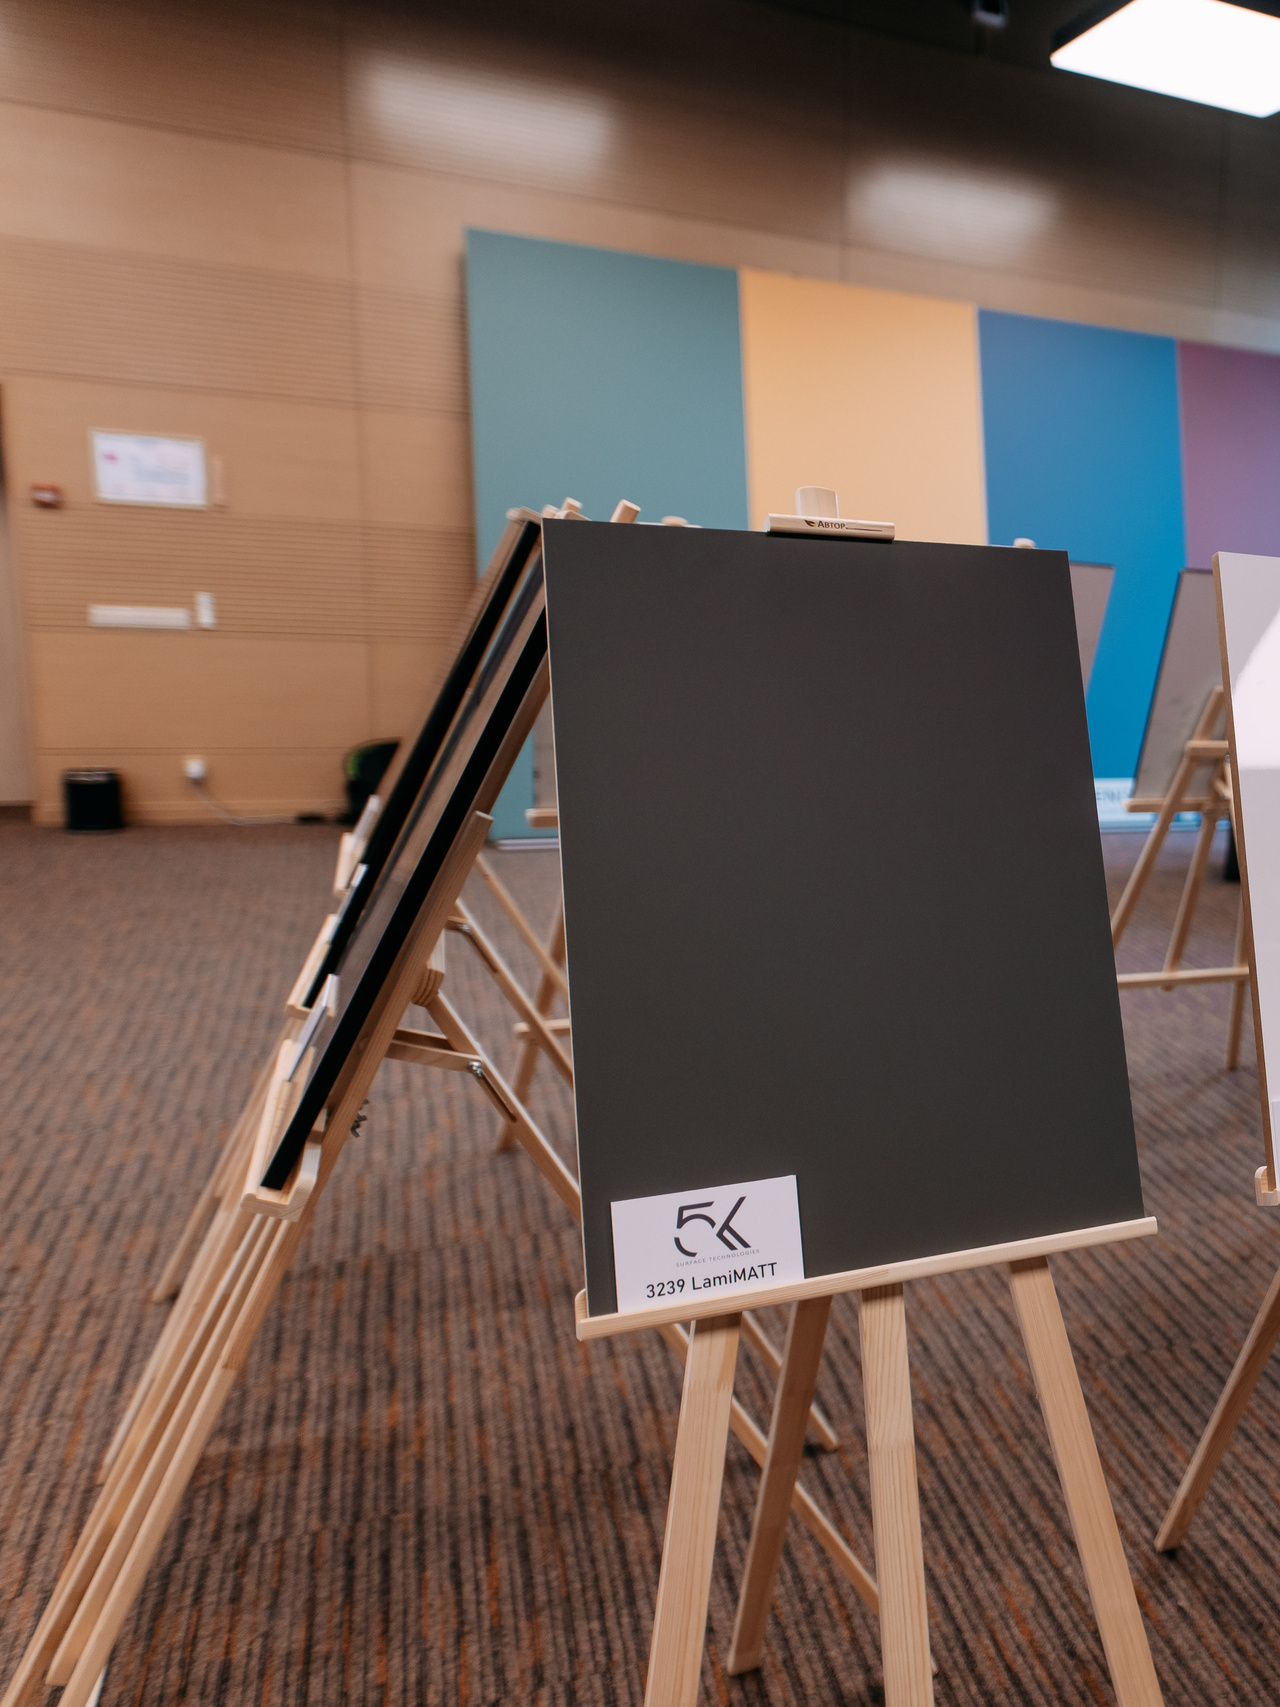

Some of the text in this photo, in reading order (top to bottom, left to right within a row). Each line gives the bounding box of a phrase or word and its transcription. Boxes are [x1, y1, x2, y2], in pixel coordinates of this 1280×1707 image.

[673, 1196, 752, 1258] 5K
[675, 1248, 761, 1268] SURFACE TECHNOLOGIES
[646, 1262, 778, 1299] 3239 LamiMATT
